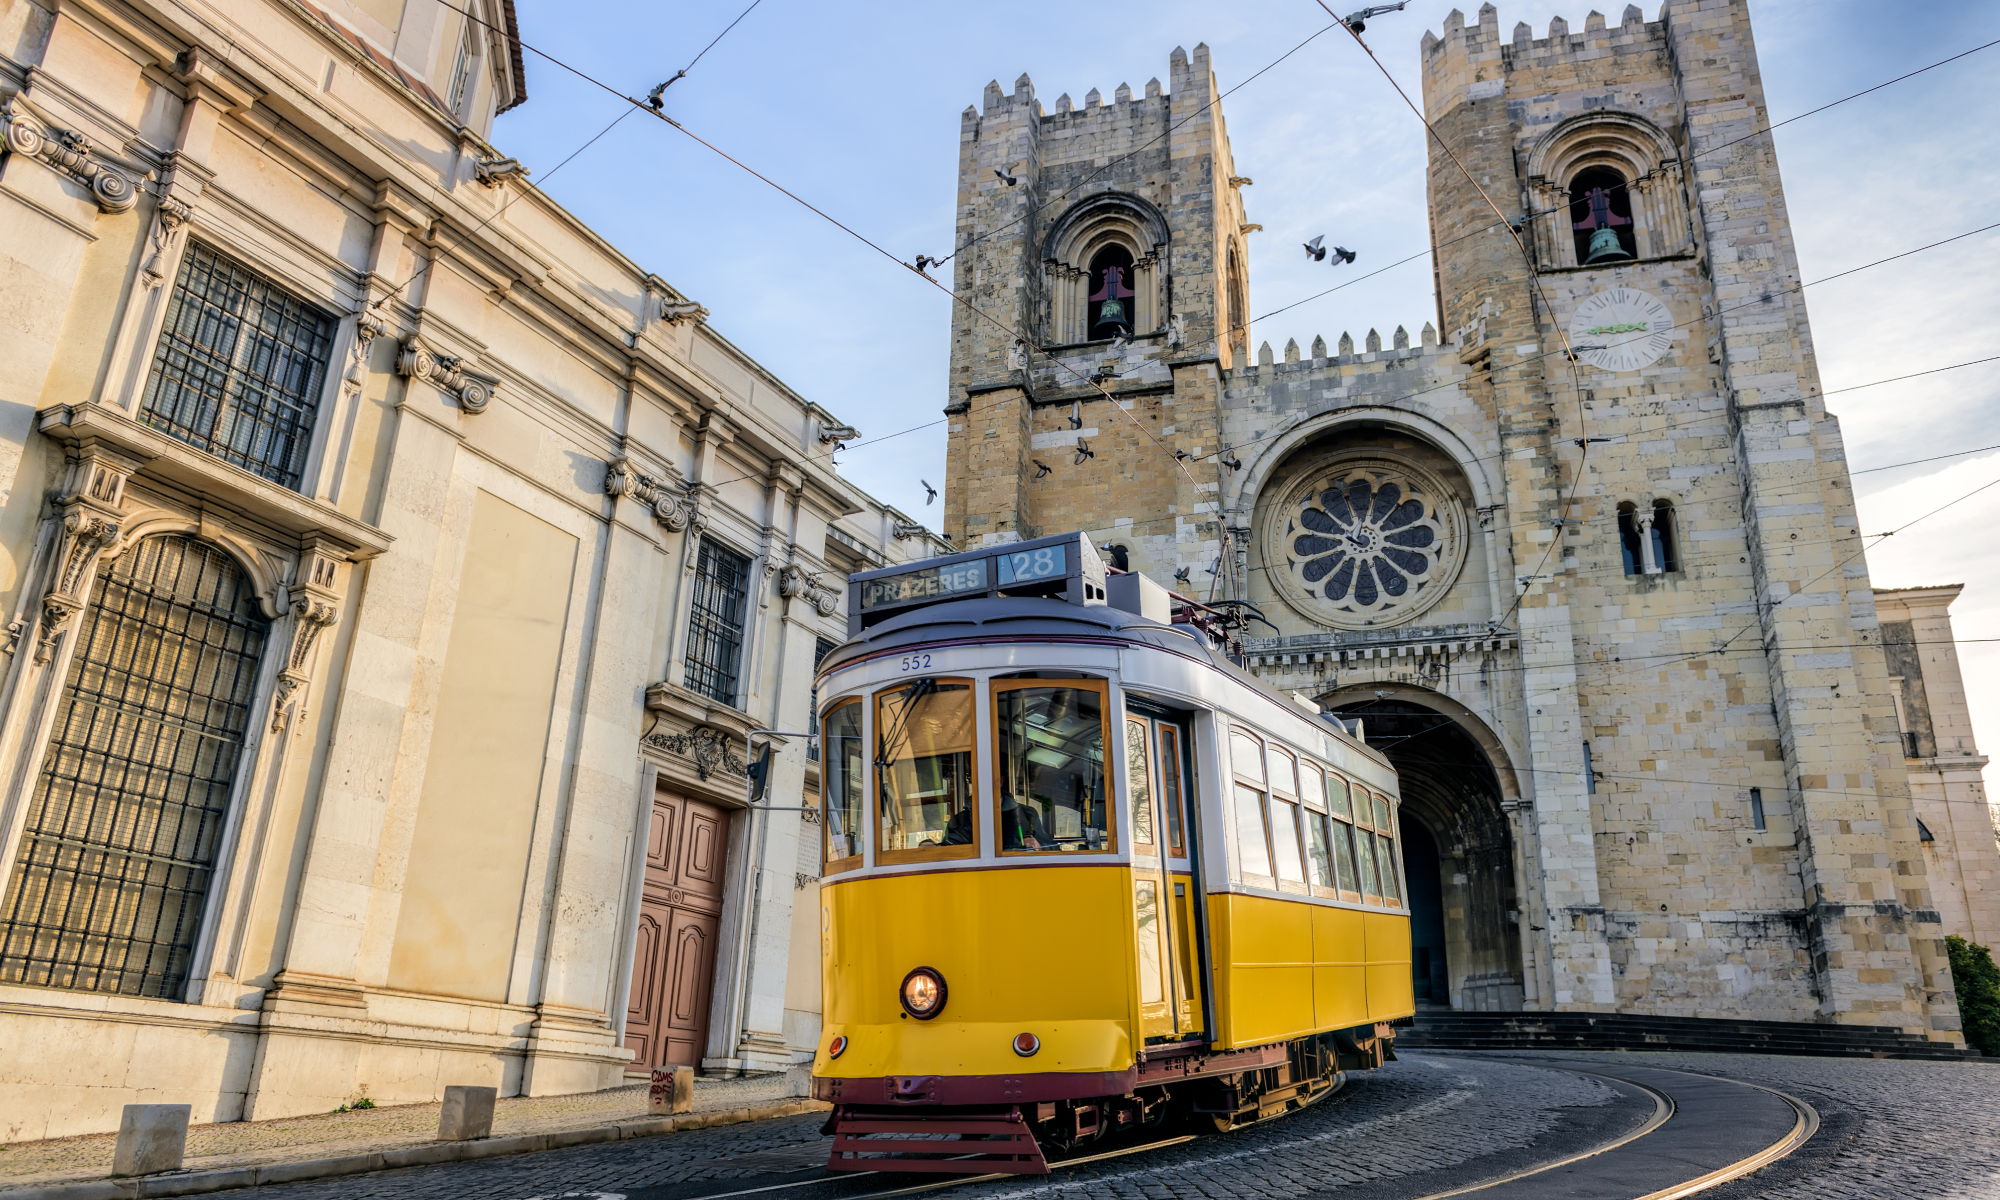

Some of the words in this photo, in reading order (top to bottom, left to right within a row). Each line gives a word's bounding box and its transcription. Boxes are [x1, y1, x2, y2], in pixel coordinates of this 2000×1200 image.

[1589, 295, 1607, 312] XI
[1609, 289, 1626, 305] XII
[1633, 292, 1643, 306] I
[1646, 303, 1664, 316] II
[1653, 320, 1671, 331] III
[1648, 334, 1670, 351] IIII
[1013, 548, 1054, 580] 28
[871, 568, 980, 603] PRAZERES
[902, 654, 932, 671] 552
